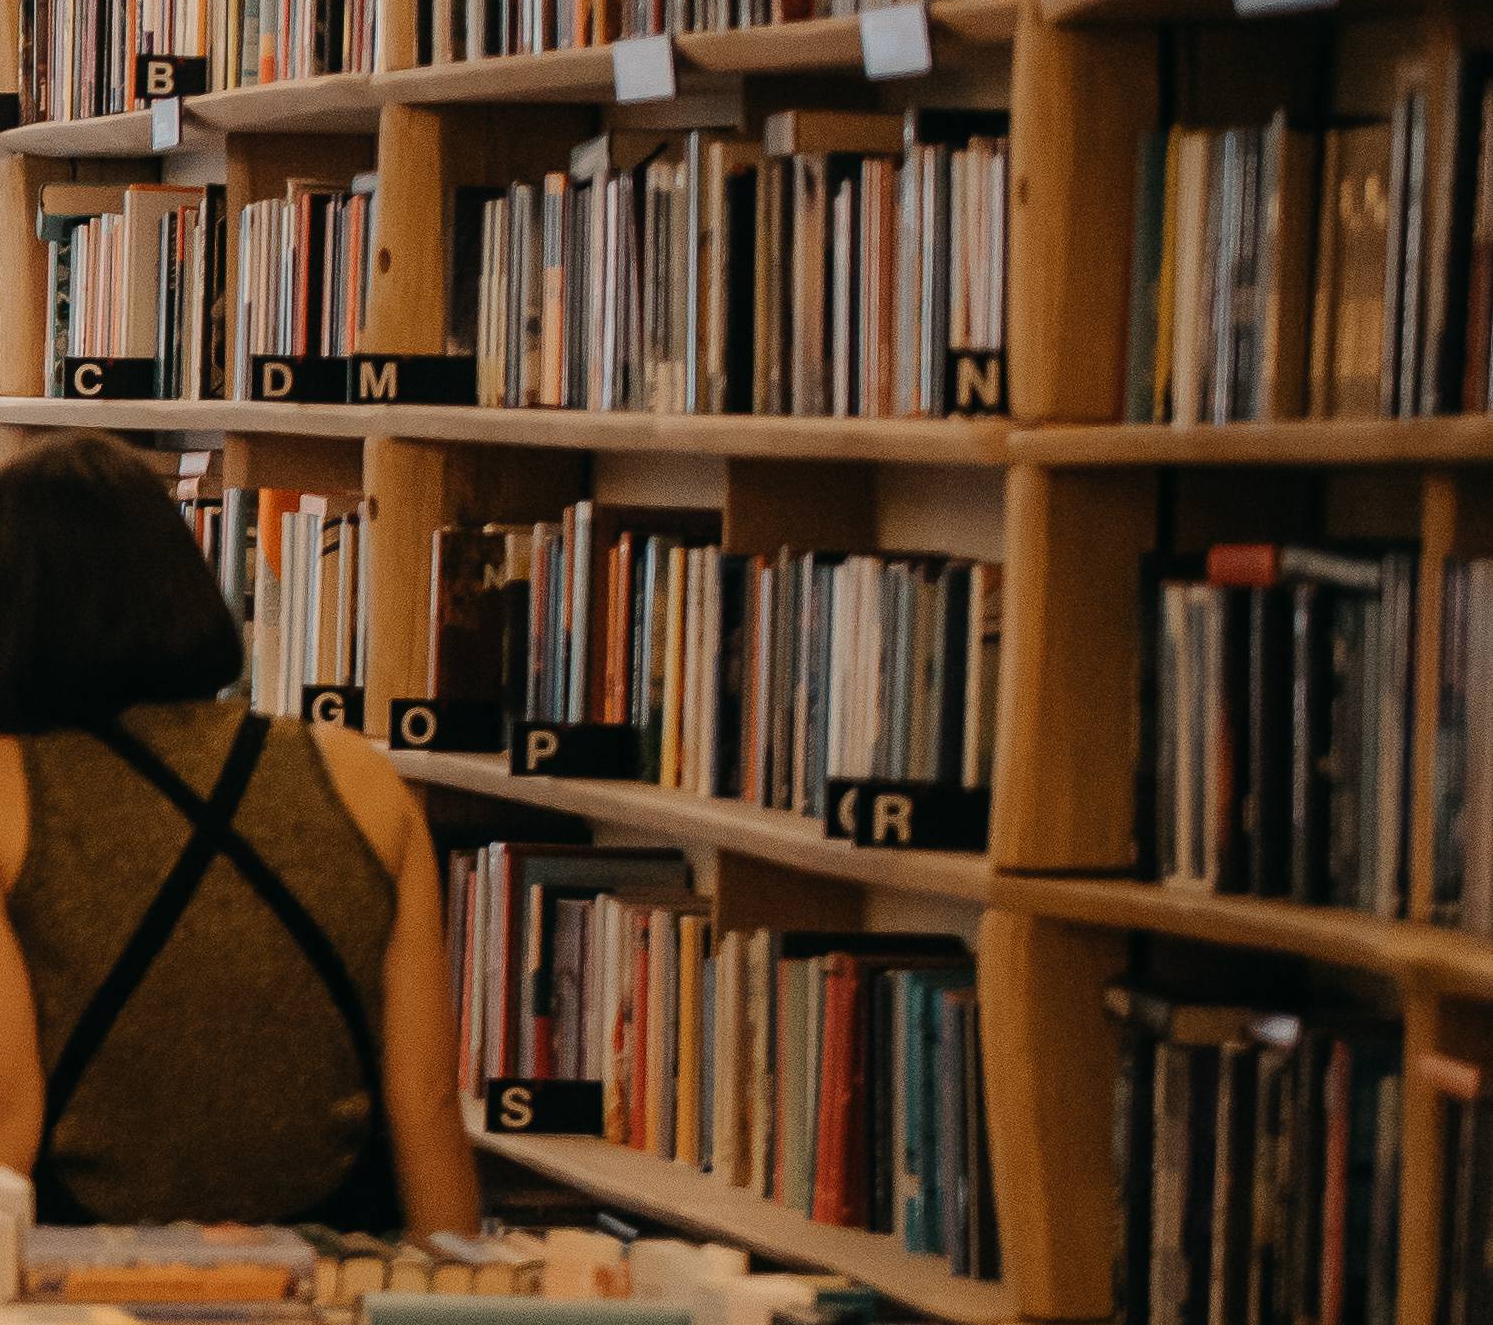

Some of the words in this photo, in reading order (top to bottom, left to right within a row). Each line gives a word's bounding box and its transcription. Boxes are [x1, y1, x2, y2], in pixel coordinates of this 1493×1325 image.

[147, 62, 175, 97] B
[73, 364, 103, 395] C
[262, 364, 293, 398] D
[359, 362, 398, 400] M
[957, 360, 1001, 413] N
[527, 730, 561, 770] P
[873, 793, 914, 844] R
[499, 1090, 535, 1129] S
